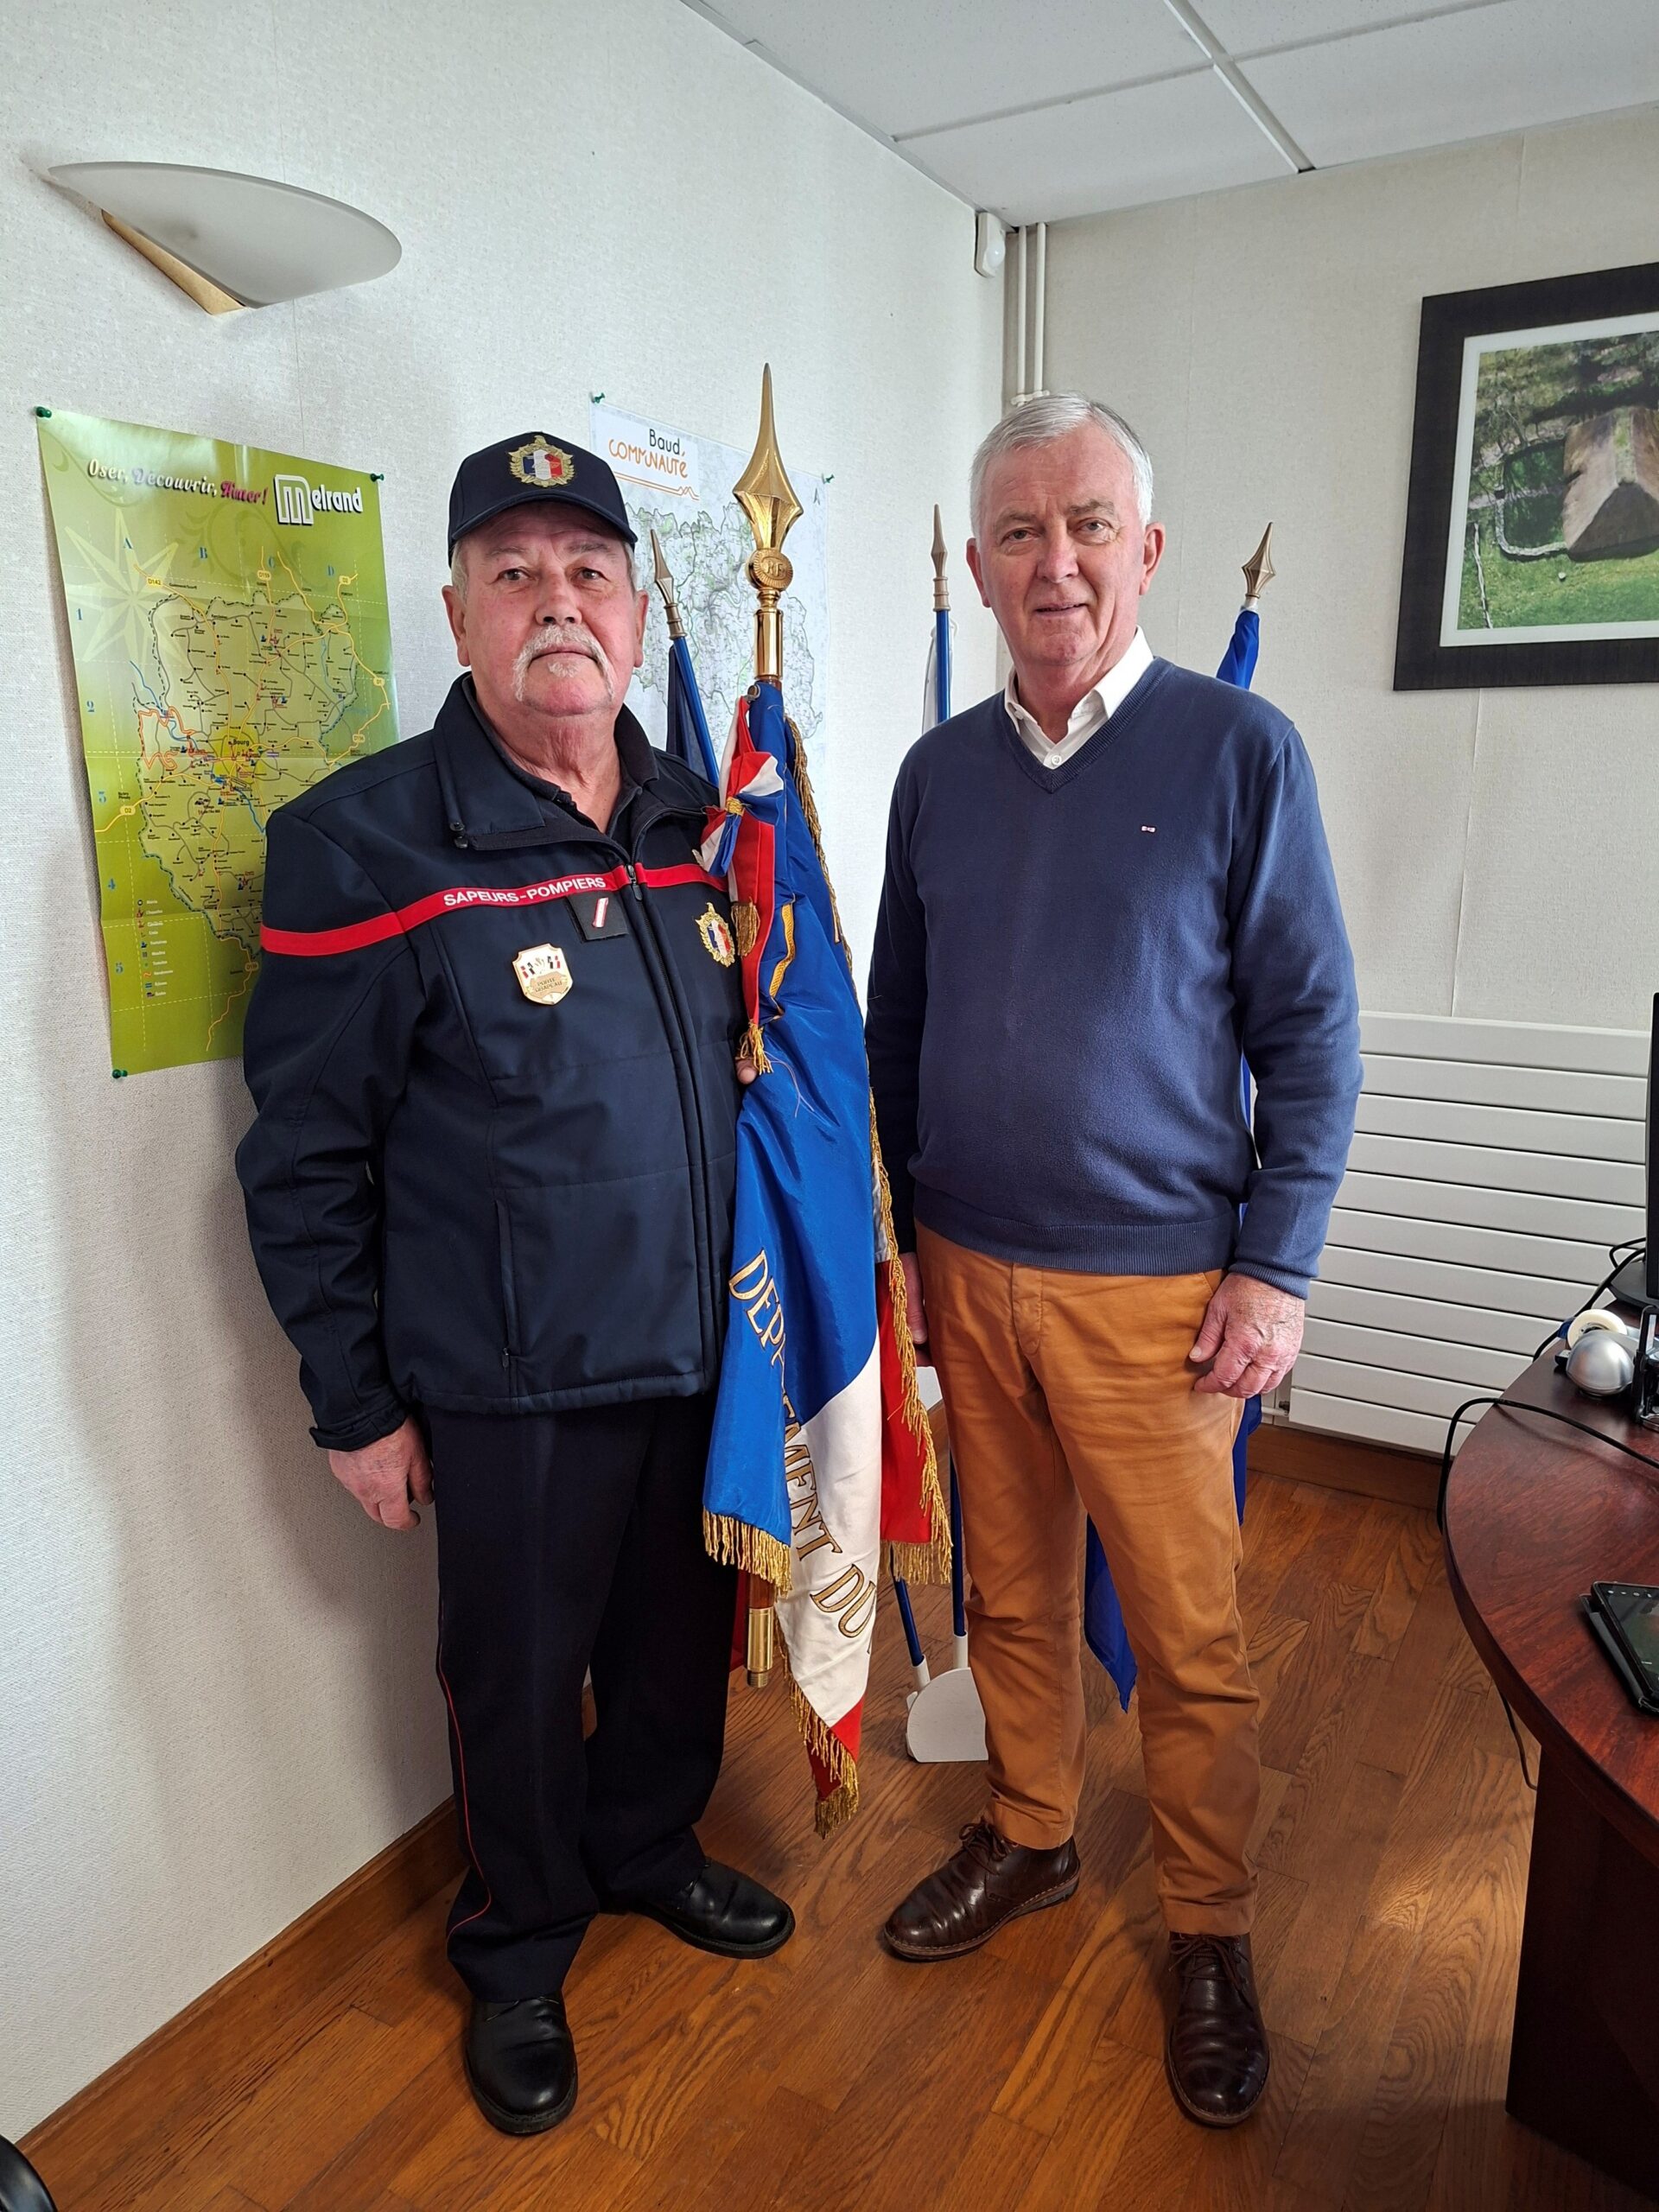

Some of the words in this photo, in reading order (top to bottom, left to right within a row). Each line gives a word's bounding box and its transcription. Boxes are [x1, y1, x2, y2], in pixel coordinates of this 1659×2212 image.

[649, 429, 680, 455] Baud
[88, 458, 129, 484] Oser,
[274, 474, 363, 525] Melrand
[124, 537, 134, 550] A
[200, 546, 208, 559] B
[86, 701, 95, 713] 2
[233, 738, 249, 747] Bourg
[108, 877, 116, 890] 4
[443, 877, 607, 906] SAPEURS-POMPIERS
[115, 962, 124, 975] 5
